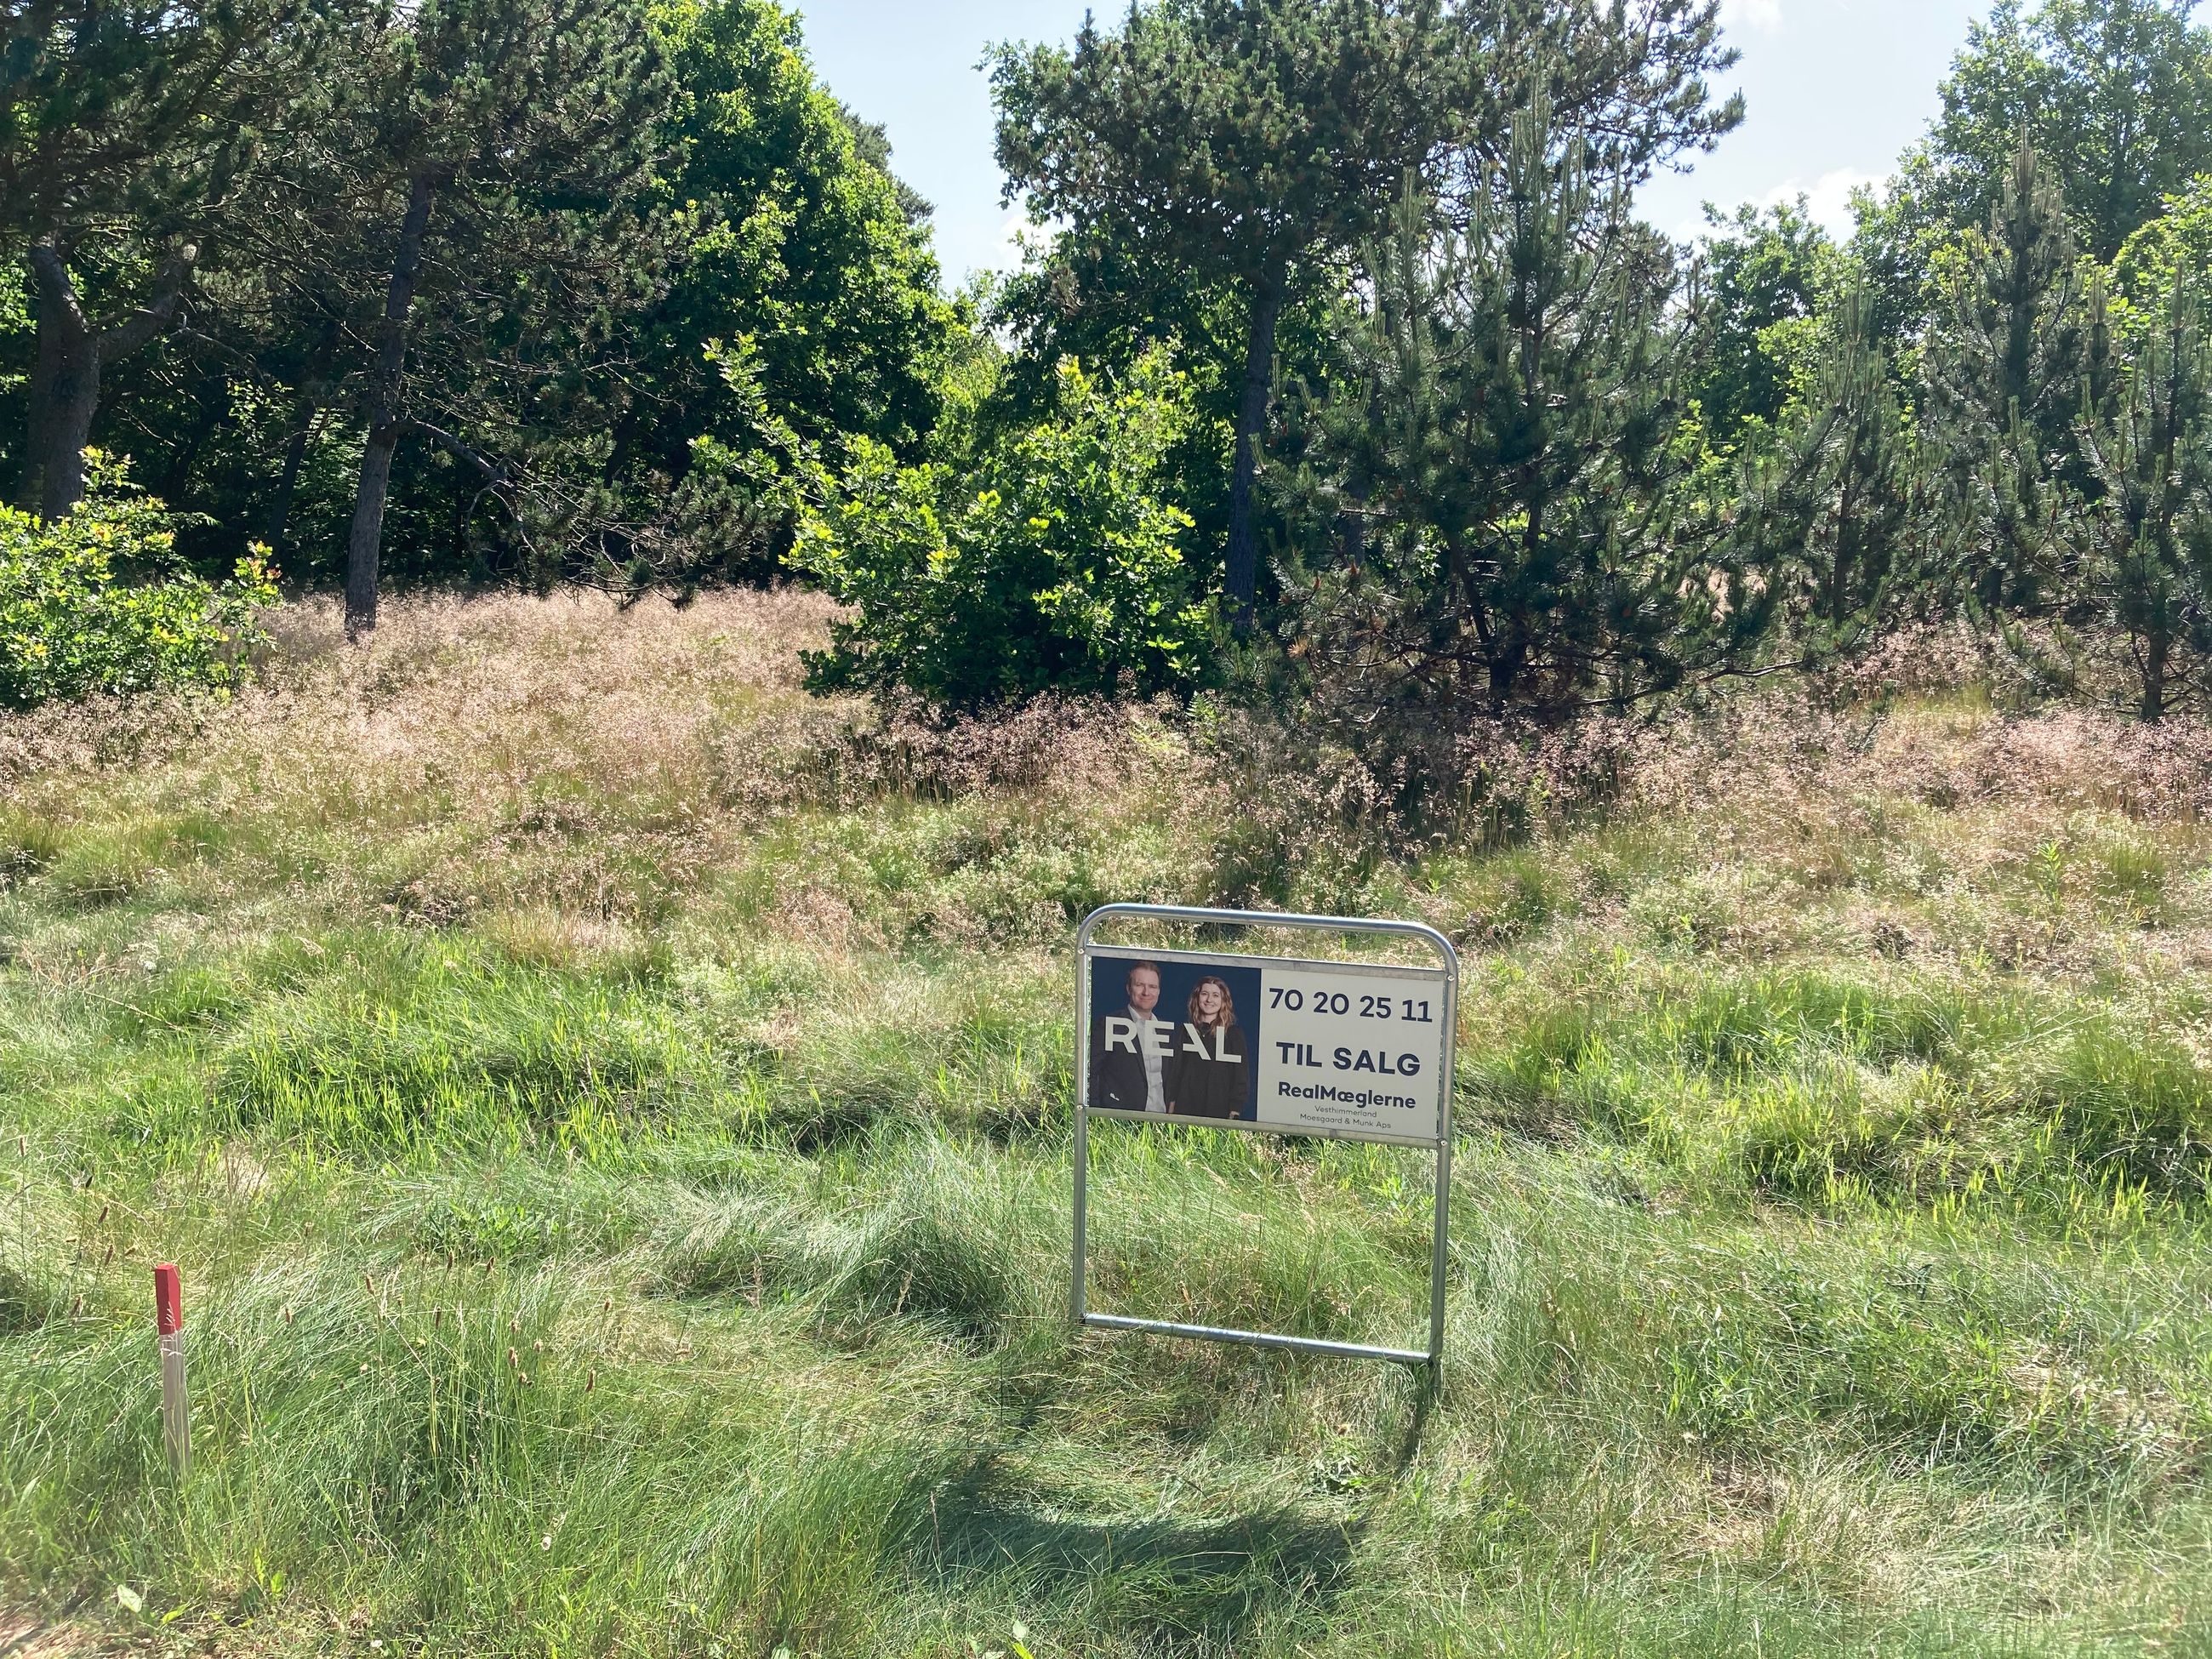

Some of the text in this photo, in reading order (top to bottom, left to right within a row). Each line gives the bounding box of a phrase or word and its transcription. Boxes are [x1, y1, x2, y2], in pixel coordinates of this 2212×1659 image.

[1269, 988, 1433, 1023] 70 20 25 11
[1104, 1016, 1242, 1063] REAL
[1276, 1041, 1421, 1076] TIL SALG
[1278, 1081, 1416, 1109] RealMæglerne
[1300, 1113, 1343, 1124] Moesgaard
[1353, 1119, 1373, 1127] Munk
[1376, 1120, 1392, 1129] Aps
[1314, 1105, 1377, 1118] Vesthimmerland
